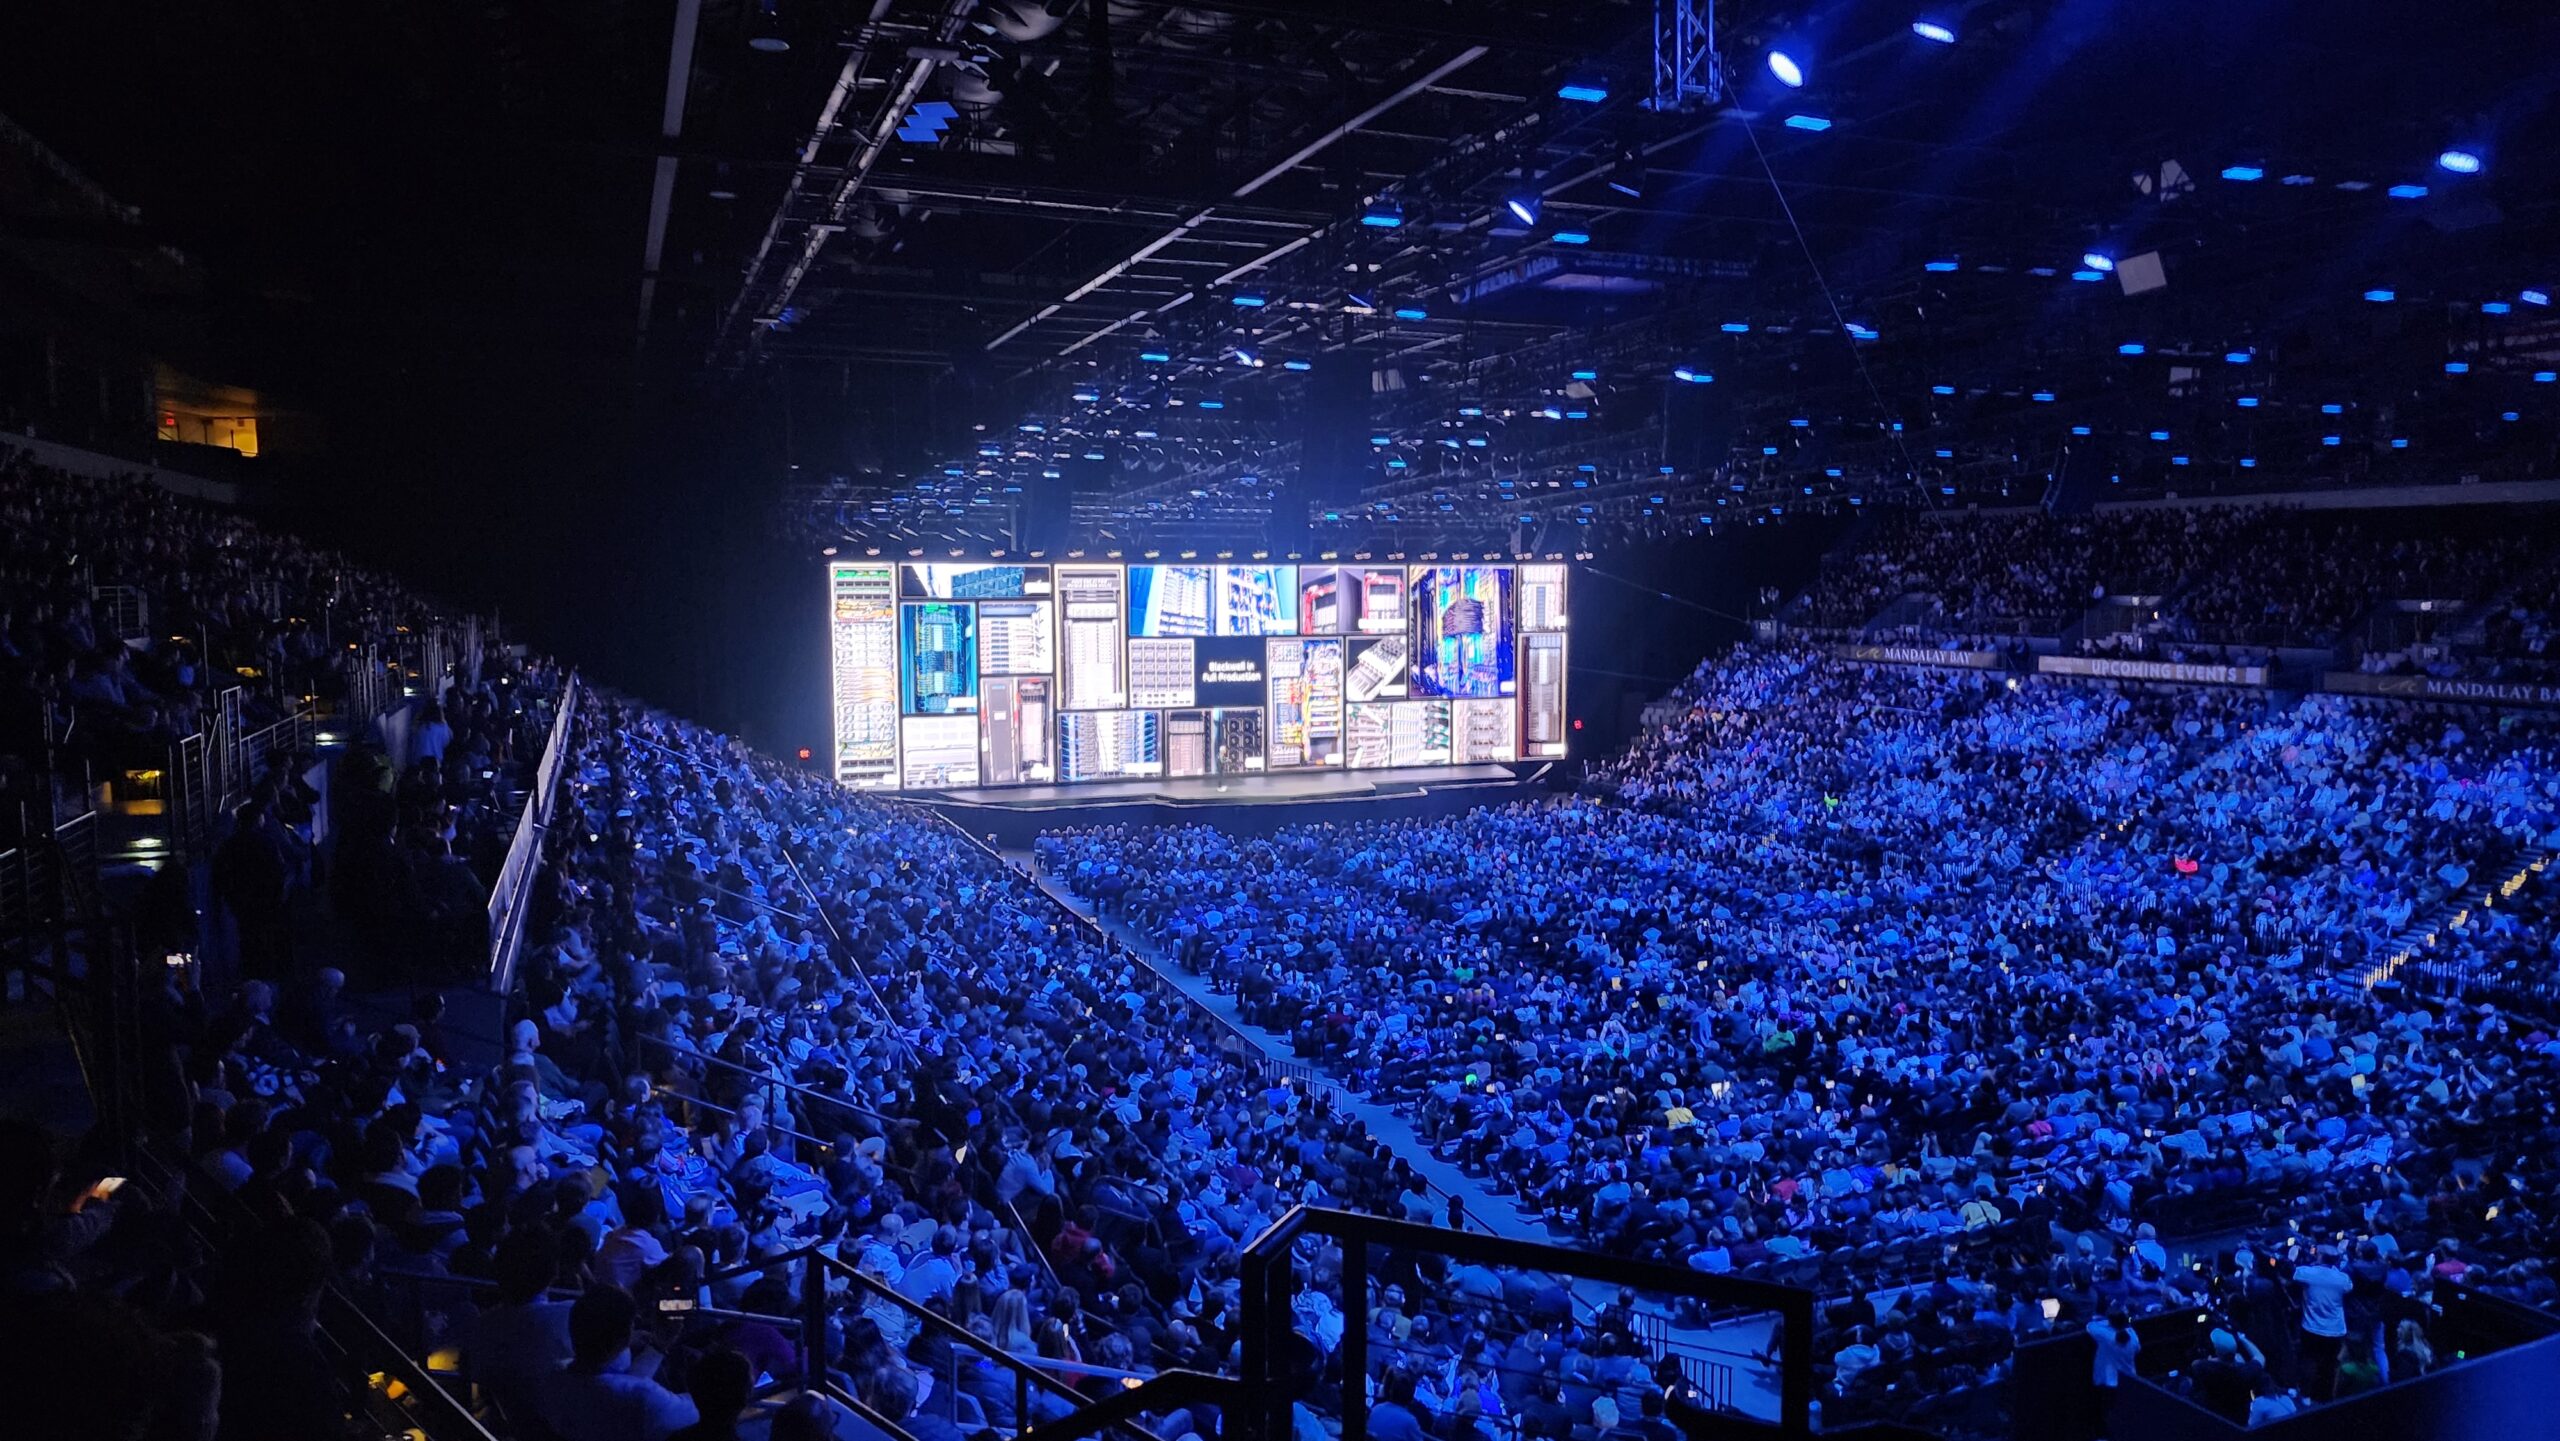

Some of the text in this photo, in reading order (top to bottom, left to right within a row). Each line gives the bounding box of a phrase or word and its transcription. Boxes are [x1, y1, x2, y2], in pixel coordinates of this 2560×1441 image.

[1884, 647, 1973, 665] MANDALAY BAY
[1208, 660, 1255, 672] Blackwell in
[2091, 659, 2171, 679] UPCOMING
[2176, 663, 2237, 682] EVENTS
[1202, 671, 1261, 682] Full Production
[2426, 679, 2533, 700] MANDALAY
